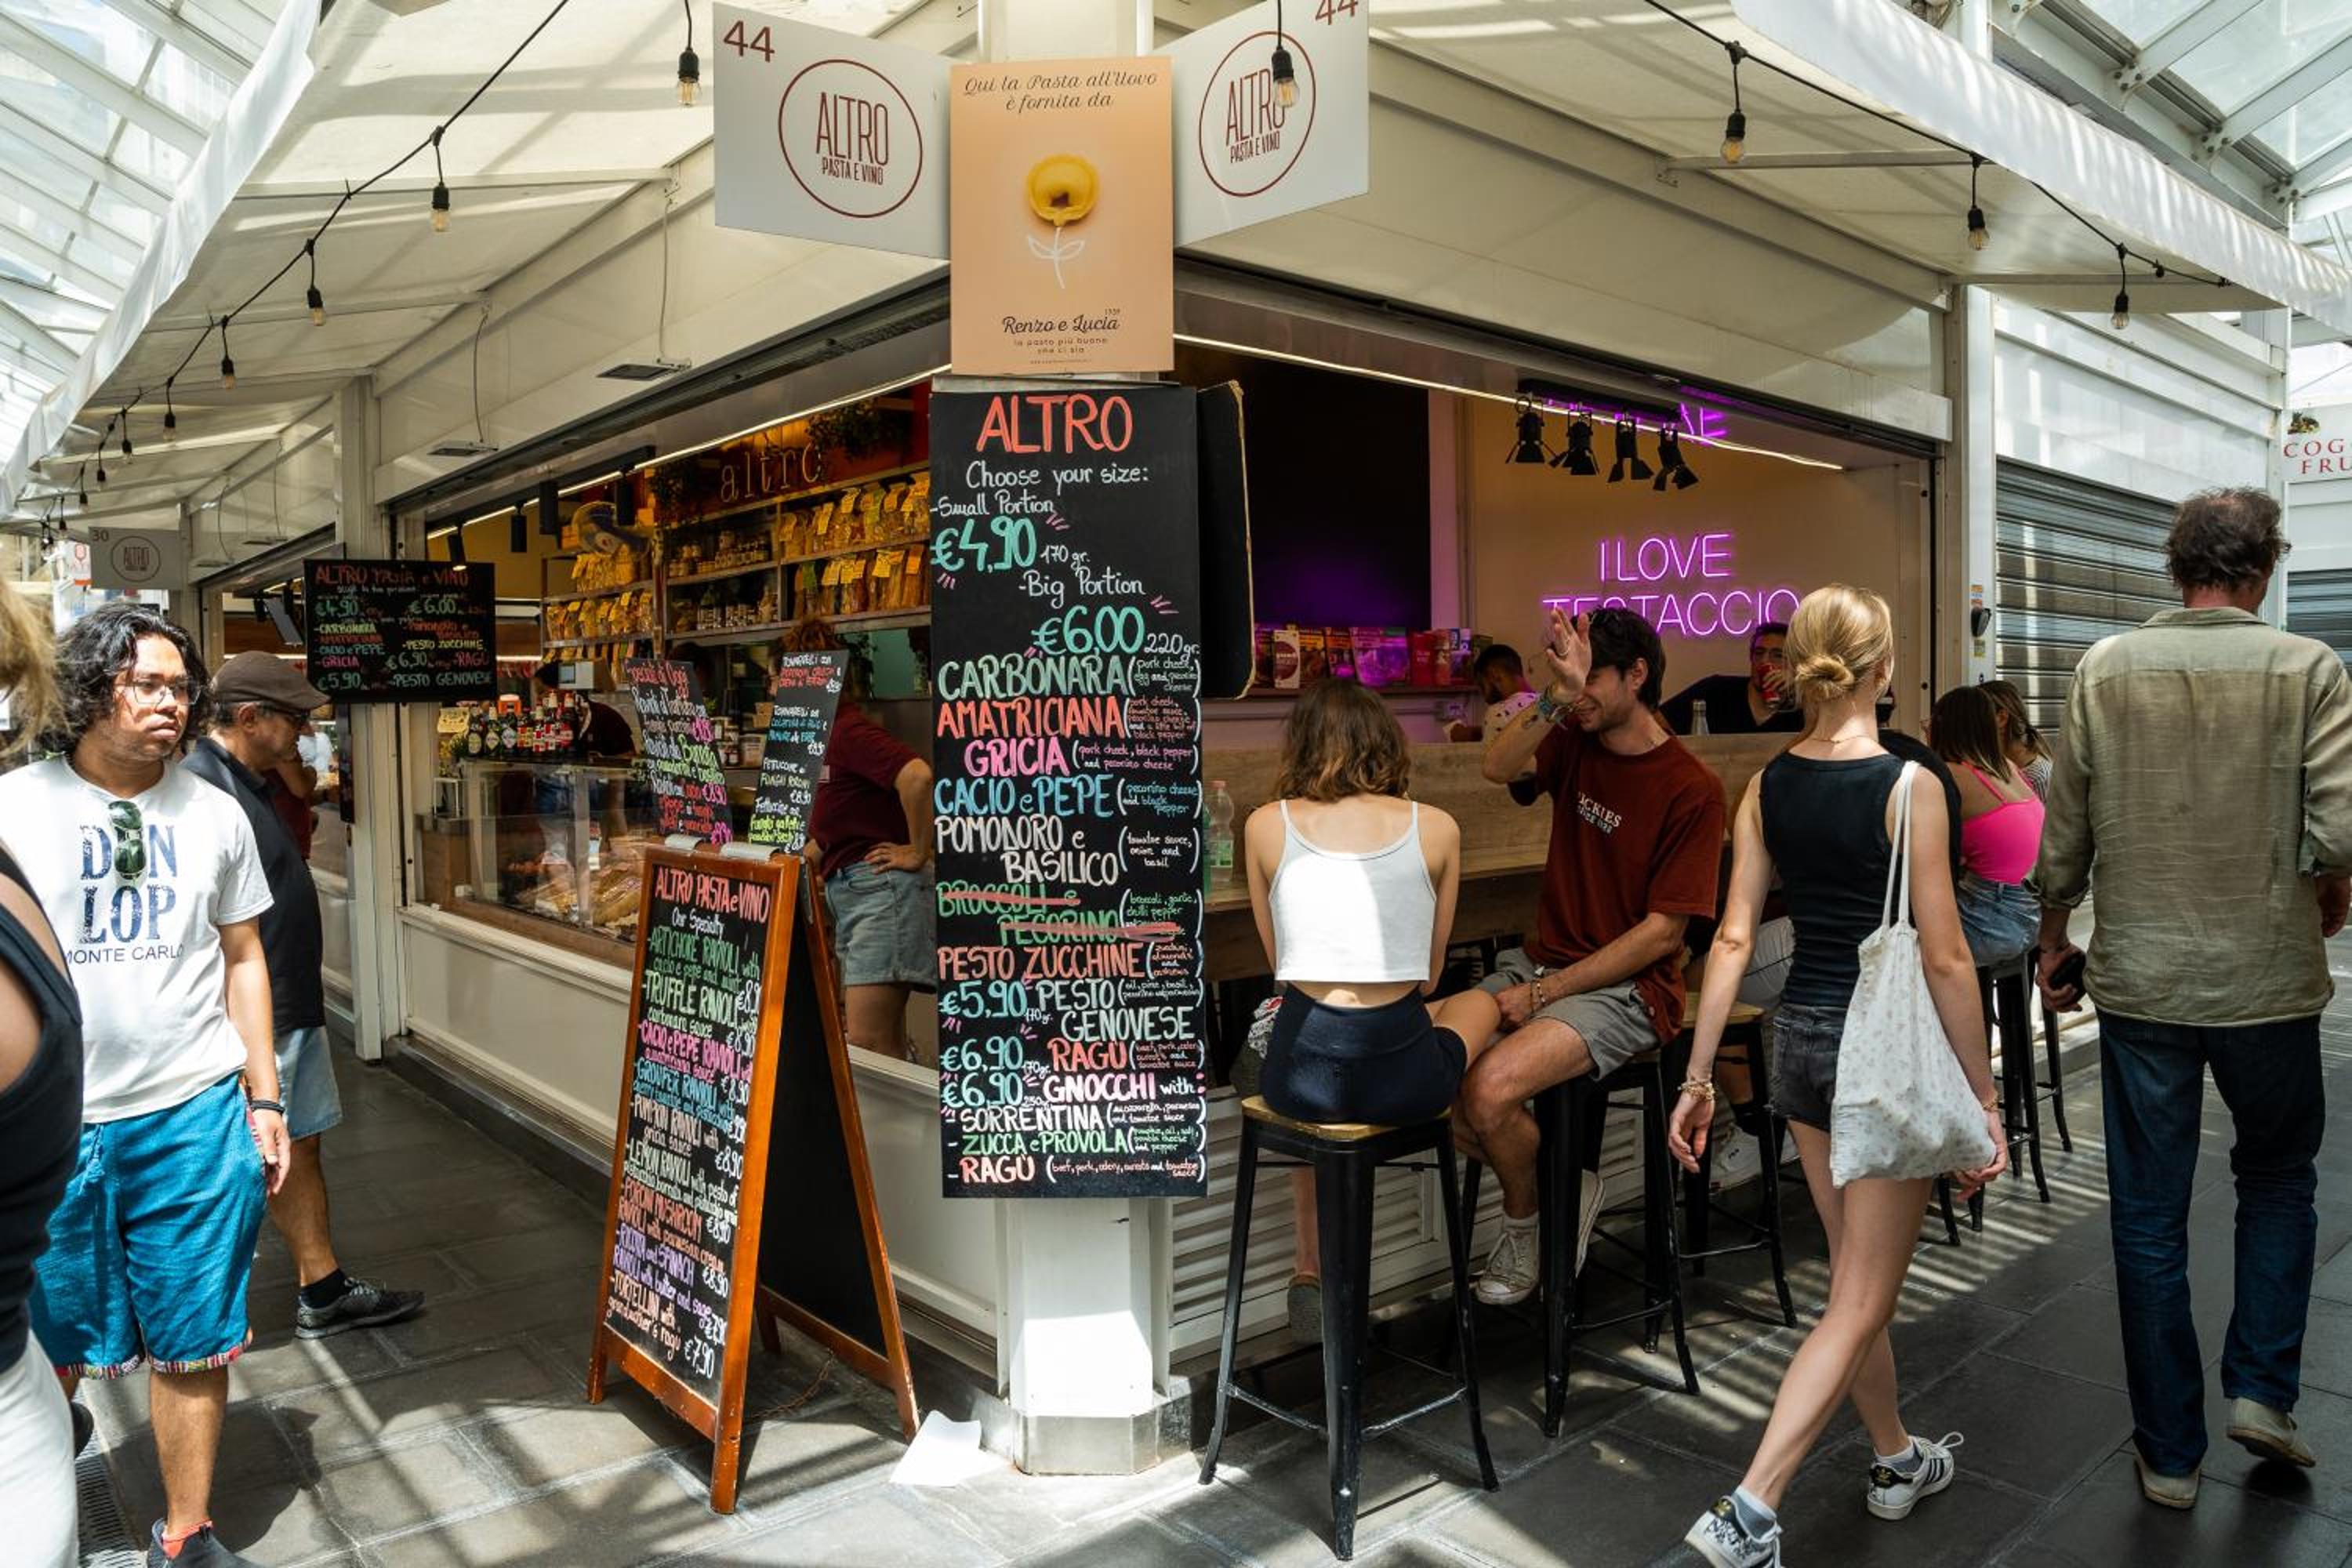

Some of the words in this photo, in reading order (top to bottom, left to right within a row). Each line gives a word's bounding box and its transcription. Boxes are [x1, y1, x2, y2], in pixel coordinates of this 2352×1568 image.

[724, 20, 775, 63] 44
[964, 78, 996, 96] Qui
[1002, 76, 1019, 91] la
[1026, 74, 1081, 89] Pasta
[1018, 93, 1081, 114] fornita
[1087, 92, 1114, 108] da
[816, 92, 889, 166] ALTRO
[1230, 139, 1254, 164] PASTA
[1255, 137, 1261, 156] E
[1261, 130, 1280, 154] VINO
[822, 157, 851, 181] PASTA
[854, 162, 860, 181] E
[862, 164, 884, 186] VINO
[1003, 316, 1054, 334] Renzo
[1058, 321, 1068, 332] e
[1073, 314, 1120, 334] Lucia
[976, 394, 1133, 454] ALTRO
[966, 460, 1041, 489] Choose
[1053, 466, 1093, 495] your
[1101, 463, 1149, 484] size:
[994, 488, 1056, 514] Portion
[93, 530, 109, 542] 30
[316, 564, 368, 585] ALTRO
[1040, 544, 1069, 565] 170
[1071, 550, 1091, 576] gr.
[1075, 566, 1145, 596] Portion
[1542, 590, 1800, 636] TTACCIO
[1144, 633, 1183, 655] 220
[938, 654, 1130, 701] CARBONARA
[937, 695, 1126, 739] AMATRICIANA
[964, 735, 1070, 778] GRICIA
[1084, 758, 1100, 768] and
[934, 776, 1015, 815] CACIO
[1020, 793, 1034, 812] e
[1032, 774, 1115, 818] PEPE
[1578, 791, 1622, 828] ICKIES
[80, 824, 177, 880] DN
[935, 815, 1063, 854] POMODORO
[1072, 829, 1086, 848] e
[1000, 851, 1119, 887] BASILICO
[1162, 846, 1180, 856] and
[655, 866, 693, 905] ALTRO
[695, 873, 730, 913] PASTA
[731, 895, 739, 912] e
[739, 882, 770, 924] VINO
[936, 880, 1047, 916] BROCCOLI
[79, 885, 176, 944] LOP
[997, 909, 1119, 946] PECORINO
[937, 946, 1015, 981] PESTO
[1023, 944, 1146, 980] ZUCCHINE
[1036, 979, 1115, 1011] PESTO
[1062, 1007, 1195, 1042] GENOVESE
[673, 1029, 700, 1063] PEPE
[1044, 1073, 1156, 1102] GNOCCHI
[960, 1105, 1104, 1134] SORRENTINA
[963, 1131, 1026, 1155] ZUCCA
[1030, 1141, 1040, 1151] e
[1040, 1130, 1128, 1155] PROVOLA
[684, 1334, 715, 1380] €7,90
